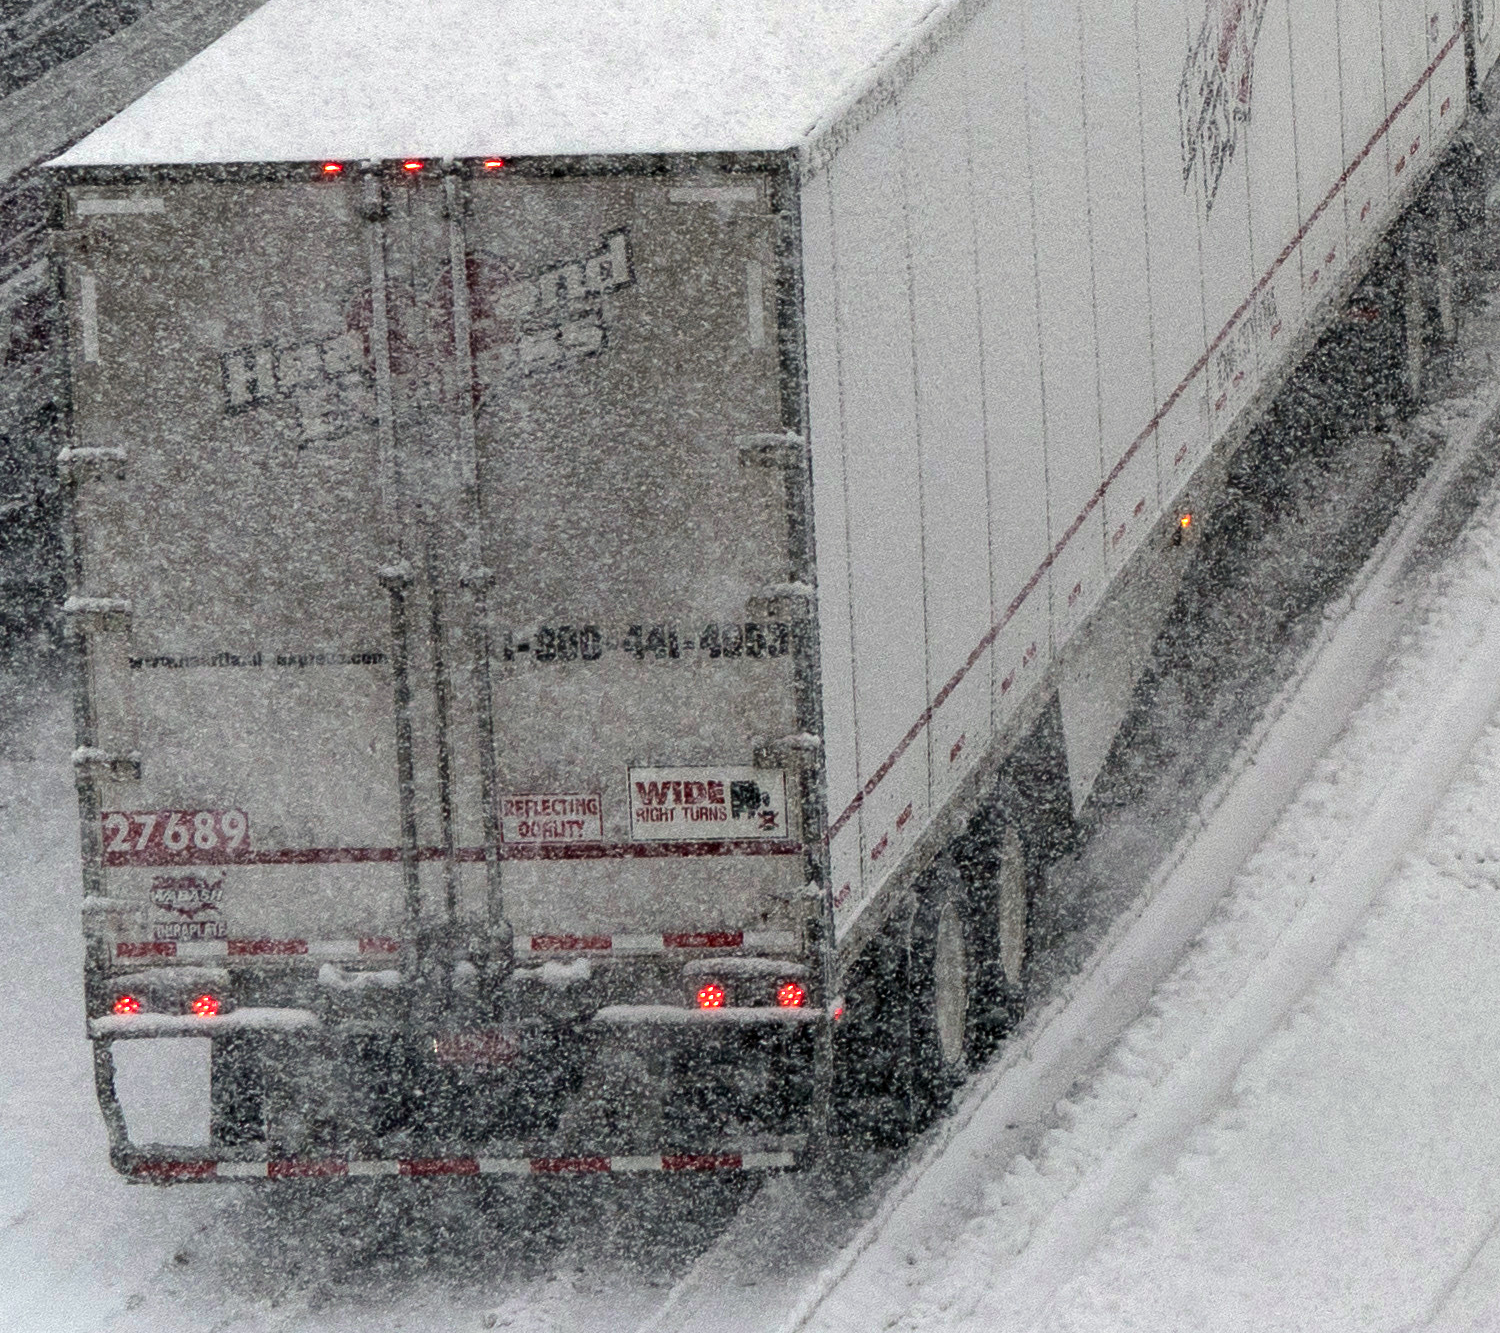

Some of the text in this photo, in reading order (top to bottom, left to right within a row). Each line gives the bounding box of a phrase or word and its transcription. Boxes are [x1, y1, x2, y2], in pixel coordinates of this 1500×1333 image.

[220, 224, 639, 416] Heaand
[634, 779, 726, 807] WIDE
[503, 797, 598, 818] REFLECTING
[635, 806, 728, 824] RIGHT TURNS
[104, 809, 248, 856] 27689
[517, 820, 585, 839] QUALITY
[150, 888, 225, 904] WABASH
